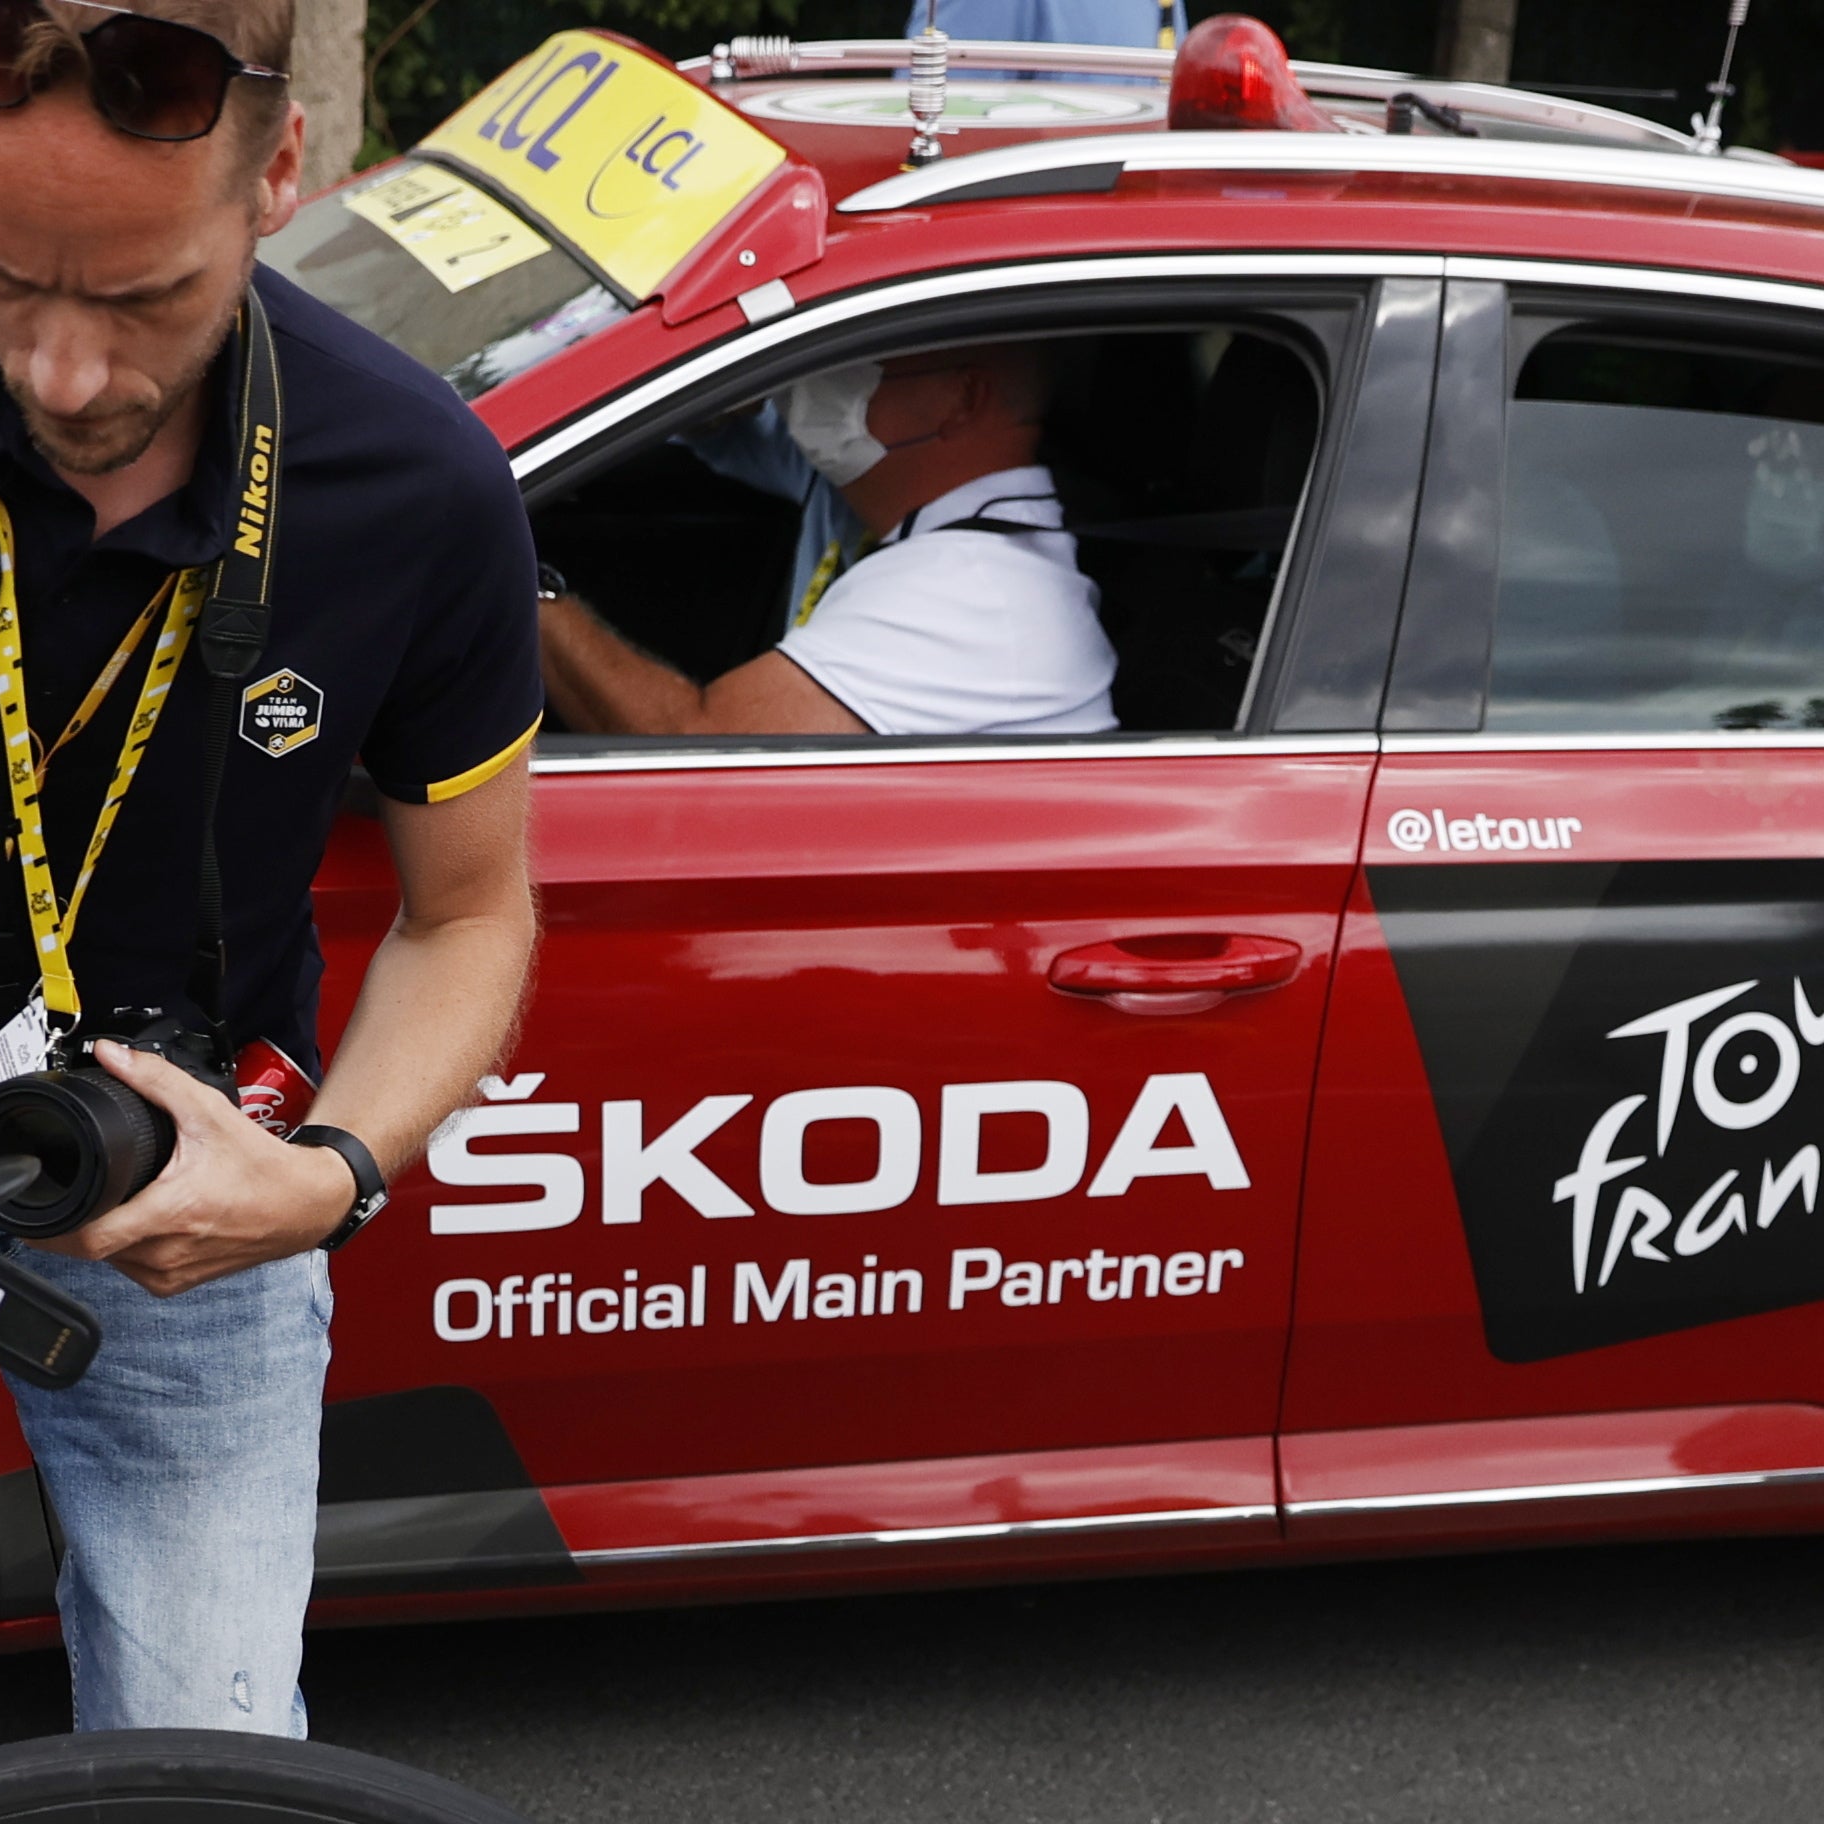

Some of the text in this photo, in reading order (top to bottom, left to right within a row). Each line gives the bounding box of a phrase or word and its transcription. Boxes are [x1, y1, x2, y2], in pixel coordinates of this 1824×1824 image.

[479, 44, 619, 172] LCL
[625, 116, 705, 191] LCL
[234, 423, 274, 559] Nikon
[254, 704, 308, 717] JUMBO
[271, 717, 305, 728] VISMA
[1387, 808, 1580, 853] @letour
[428, 1071, 1252, 1235] ŠKODA
[432, 1247, 1244, 1342] Official Main Partner
